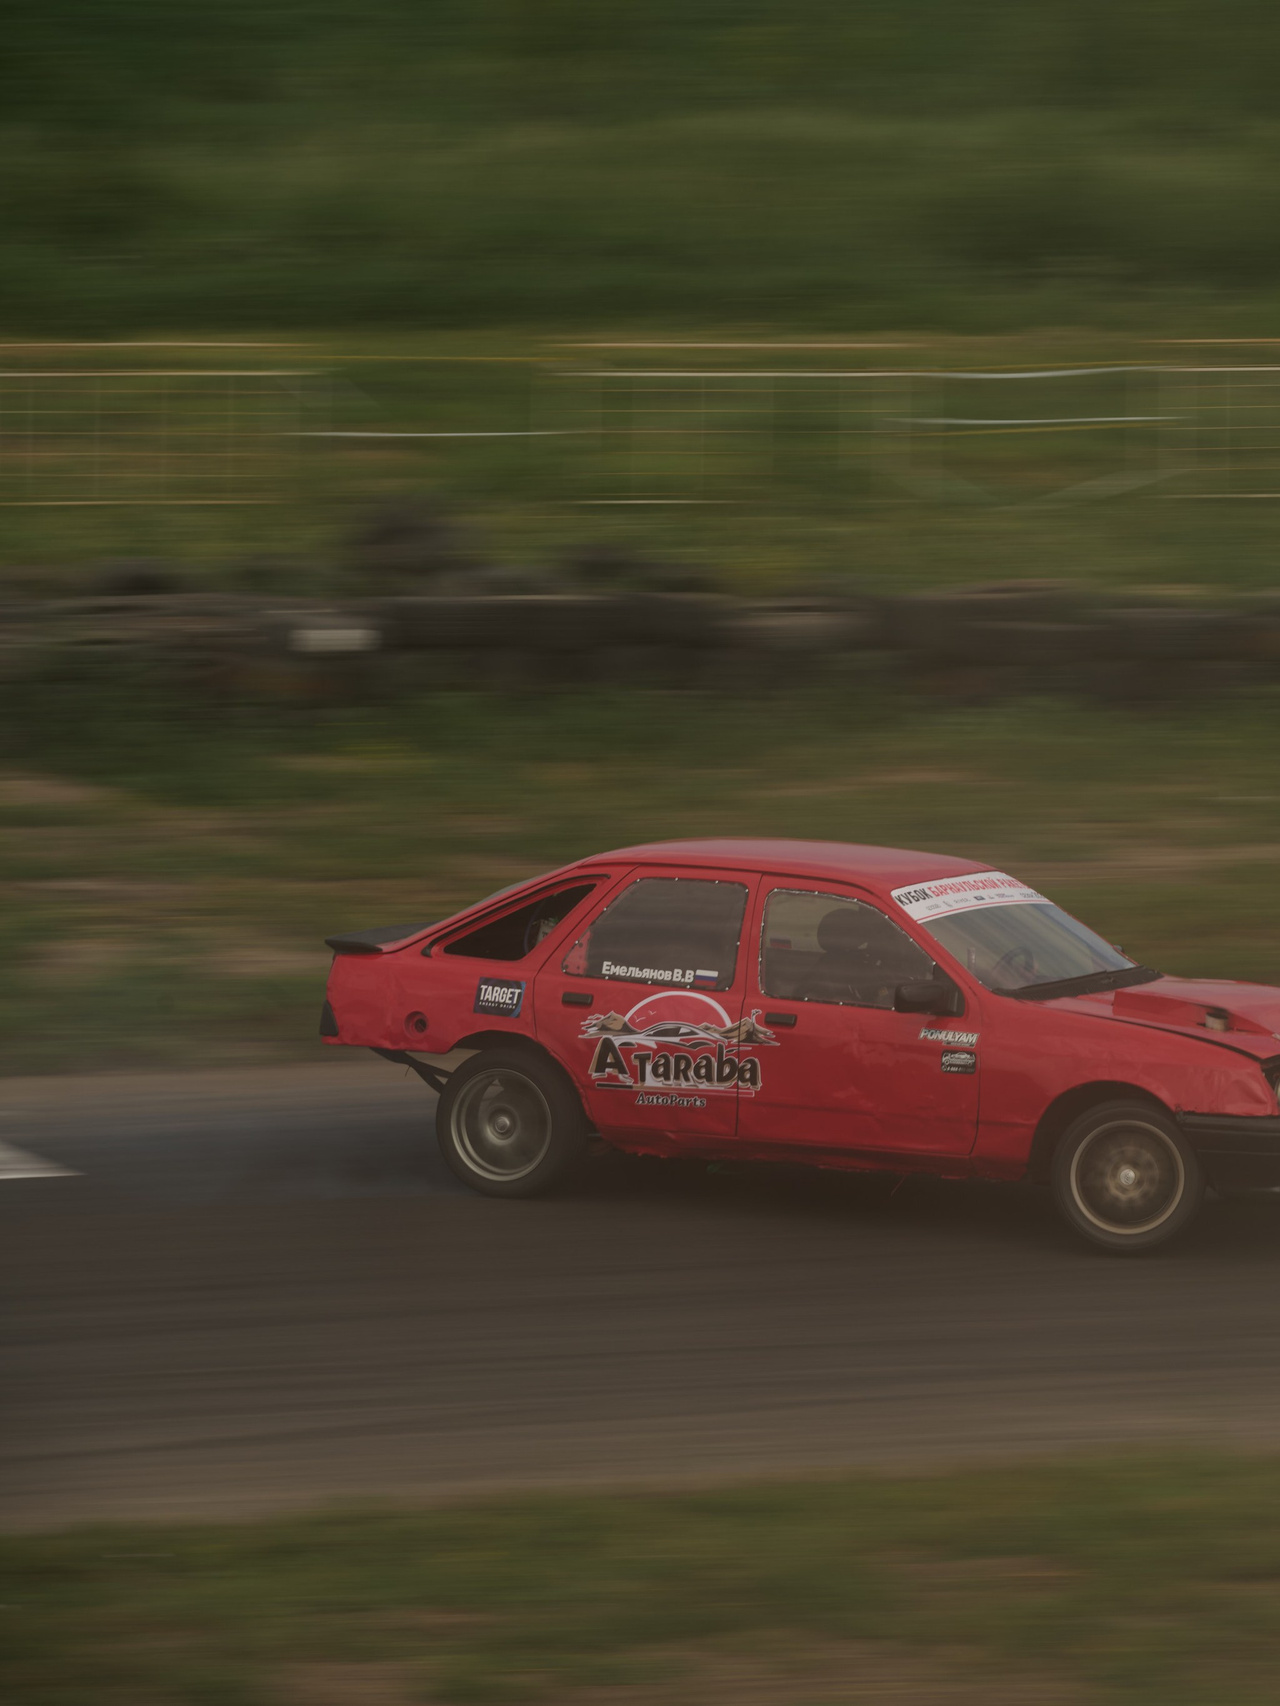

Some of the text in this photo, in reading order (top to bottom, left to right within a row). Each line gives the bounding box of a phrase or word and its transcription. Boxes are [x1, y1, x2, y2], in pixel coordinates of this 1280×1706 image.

[895, 888, 934, 906] КУБОК
[928, 877, 1001, 897] БАРНАУЛЬСКОЙ
[601, 961, 673, 981] Емельянов
[480, 984, 522, 1004] TARGET
[636, 1092, 706, 1107] AutoParts
